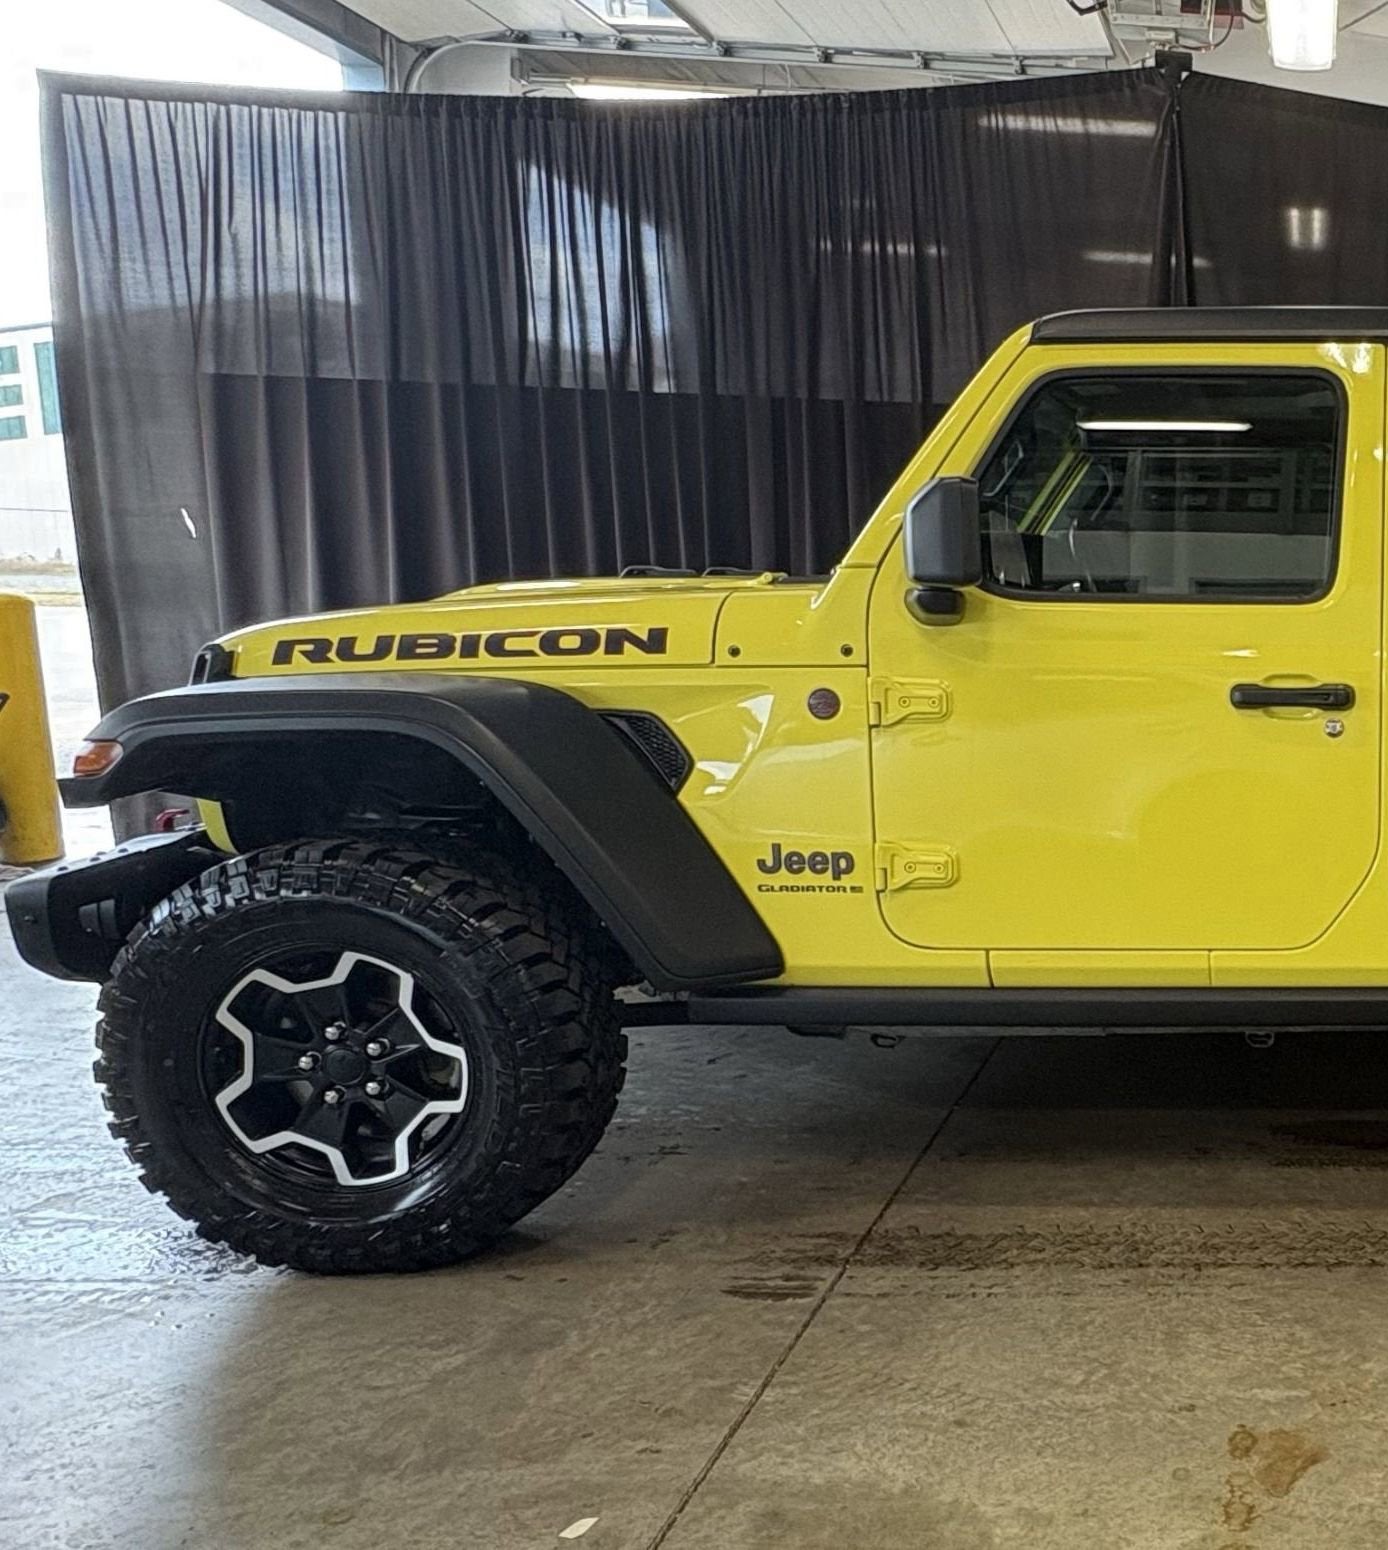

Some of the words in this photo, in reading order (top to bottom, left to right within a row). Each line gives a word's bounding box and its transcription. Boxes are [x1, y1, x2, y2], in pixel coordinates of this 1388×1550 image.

[272, 627, 669, 665] RUBICON
[756, 842, 855, 881] Jeep
[757, 884, 848, 893] GLADIATOR
